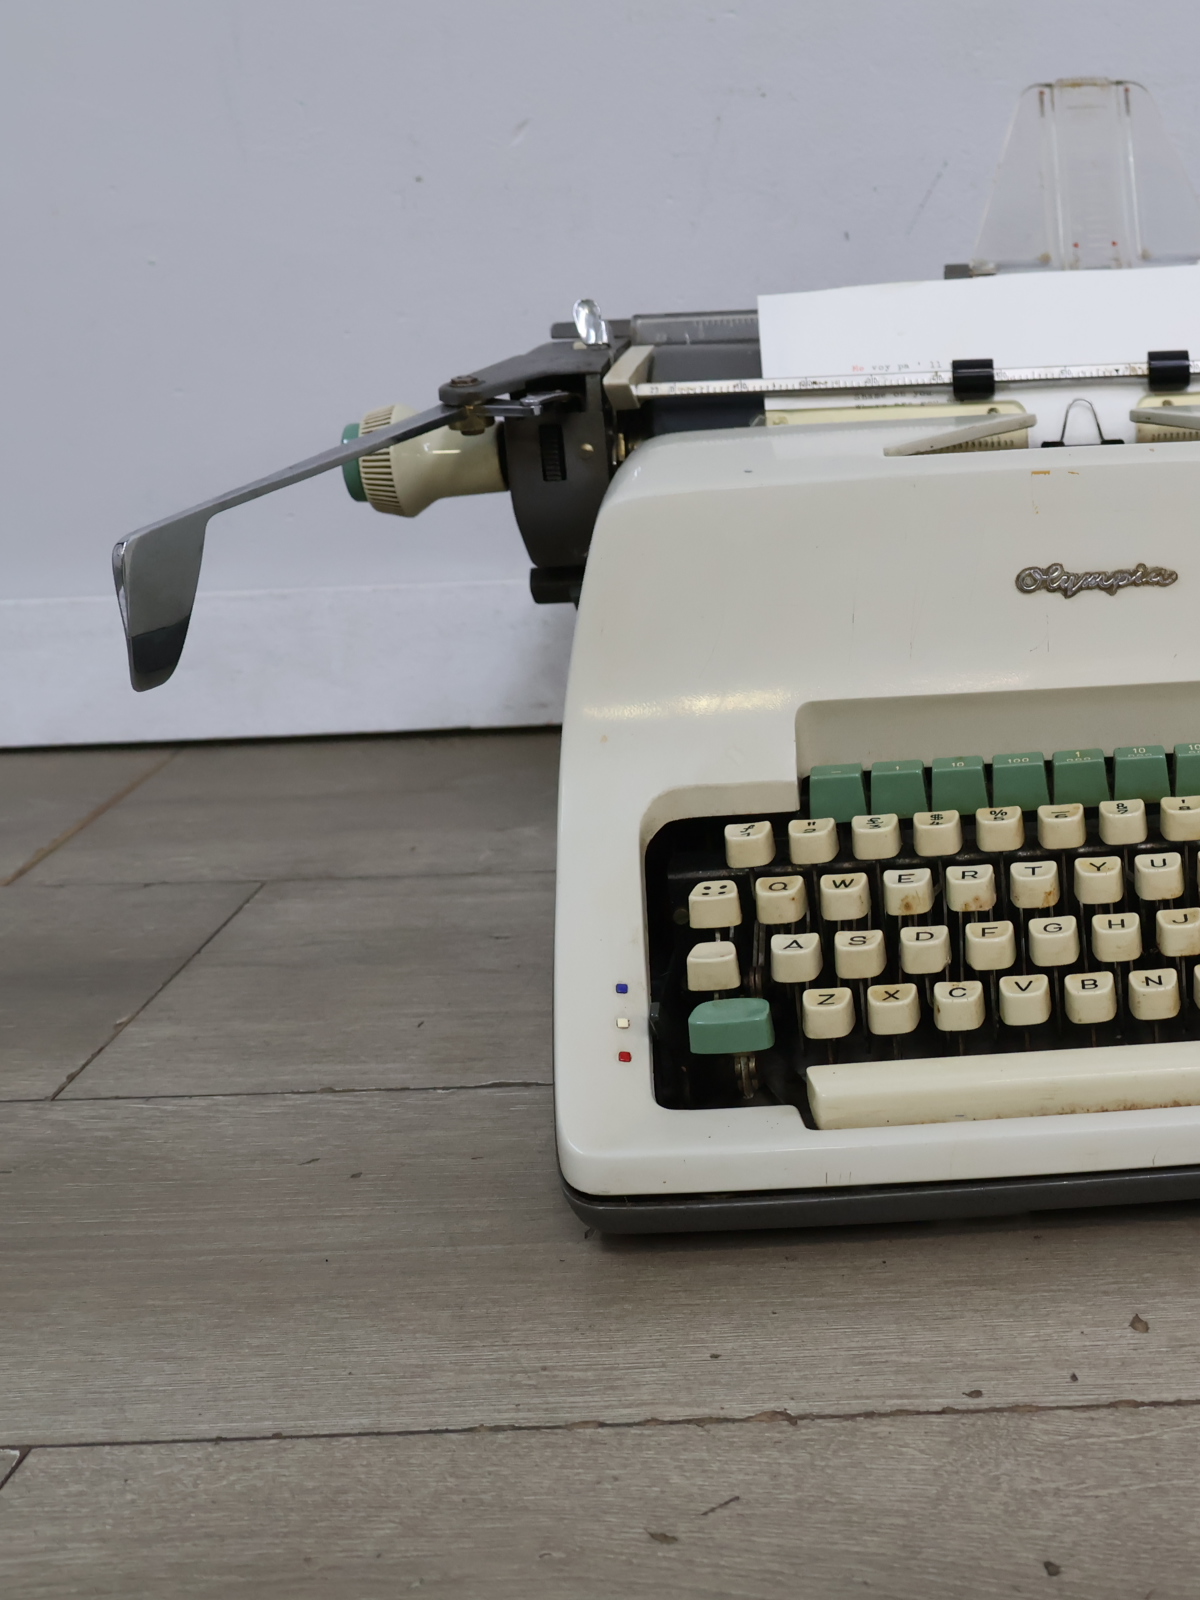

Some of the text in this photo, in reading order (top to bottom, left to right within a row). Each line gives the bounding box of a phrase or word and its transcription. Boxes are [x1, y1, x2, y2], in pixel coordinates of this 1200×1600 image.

[1015, 563, 1178, 599] Olympia
[768, 881, 789, 892] Q
[832, 878, 854, 888] W
[898, 873, 915, 883] E
[961, 870, 978, 880] R
[1024, 866, 1043, 876] T
[1089, 862, 1108, 872] Y
[1150, 858, 1167, 868] U
[783, 940, 804, 950] A
[848, 936, 868, 946] S
[915, 932, 934, 942] D
[981, 926, 998, 937] F
[1043, 922, 1063, 933] G
[1107, 918, 1126, 929] H
[1172, 914, 1188, 924] J
[817, 994, 836, 1005] Z
[882, 990, 900, 1000] X
[948, 987, 967, 998] C
[1014, 980, 1034, 992] V
[1080, 978, 1098, 990] B
[1144, 975, 1163, 986] N
